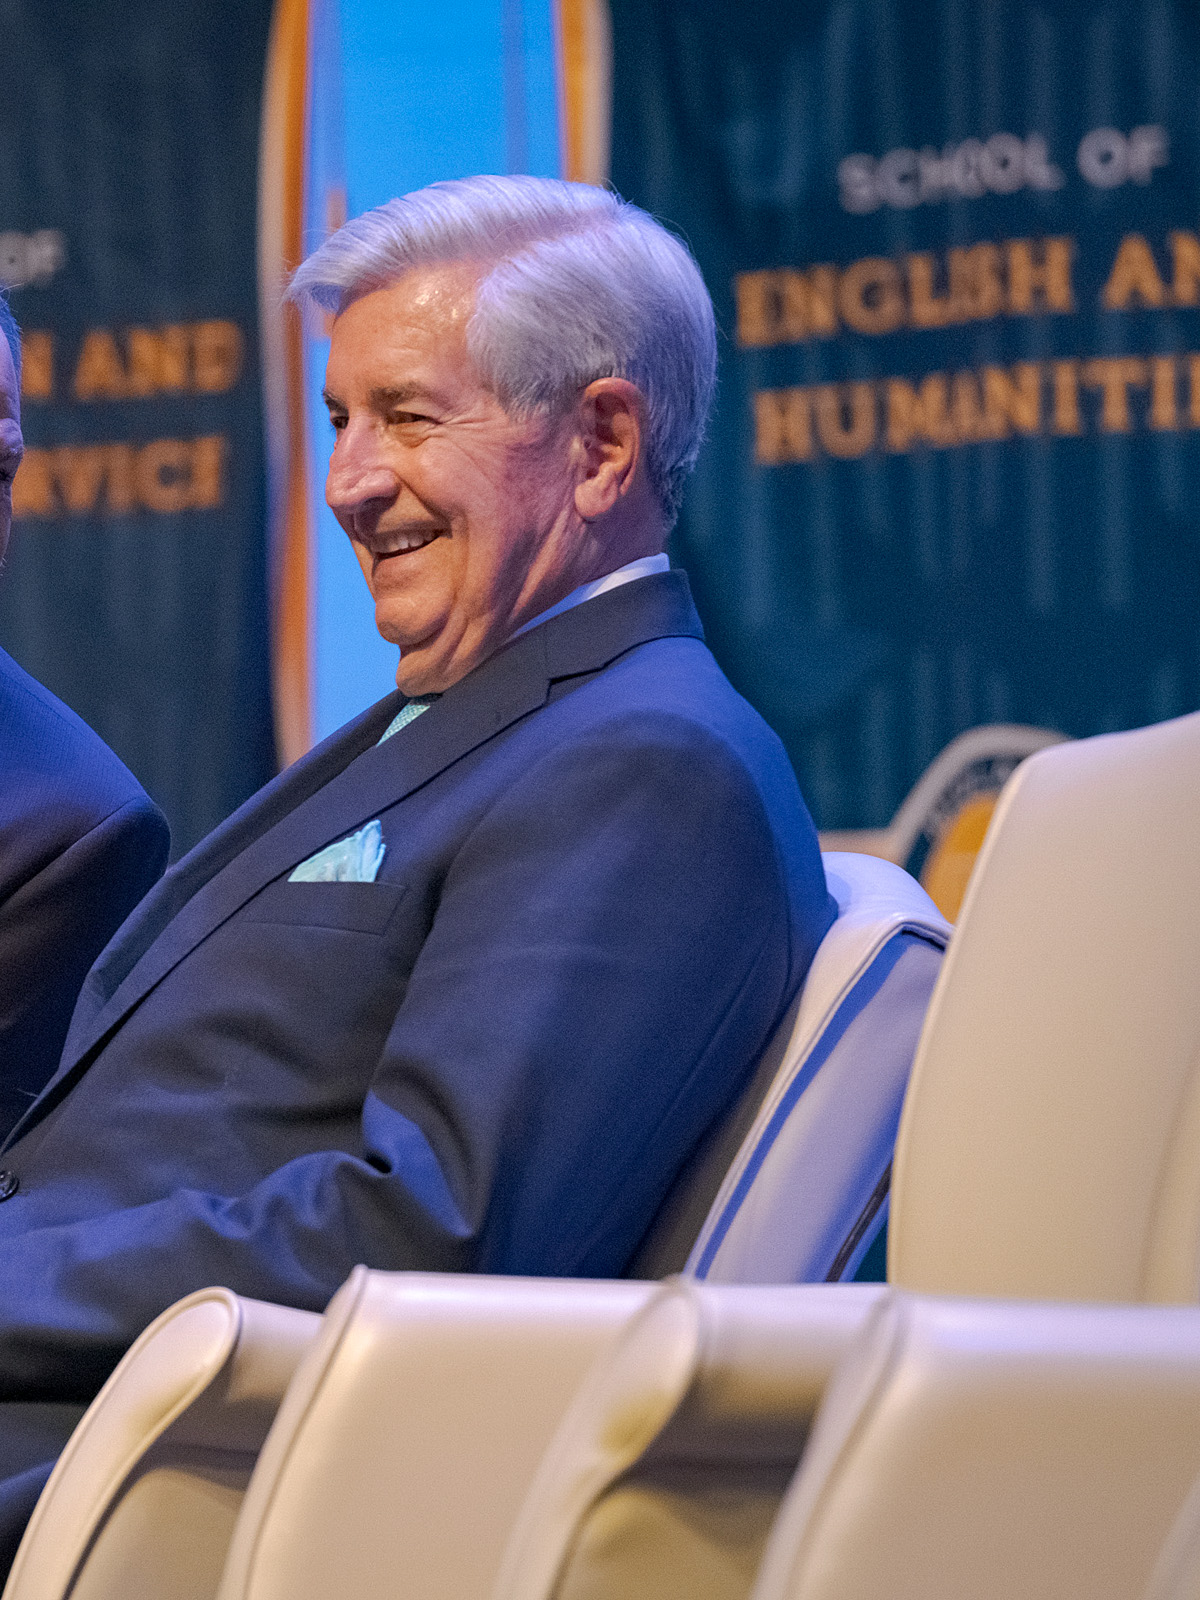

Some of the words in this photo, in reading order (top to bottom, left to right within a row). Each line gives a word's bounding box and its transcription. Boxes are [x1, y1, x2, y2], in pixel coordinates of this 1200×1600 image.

[838, 130, 1065, 214] SCHOOL
[1077, 124, 1168, 189] OF
[74, 318, 242, 399] AND
[753, 352, 1200, 466] HUMANITI
